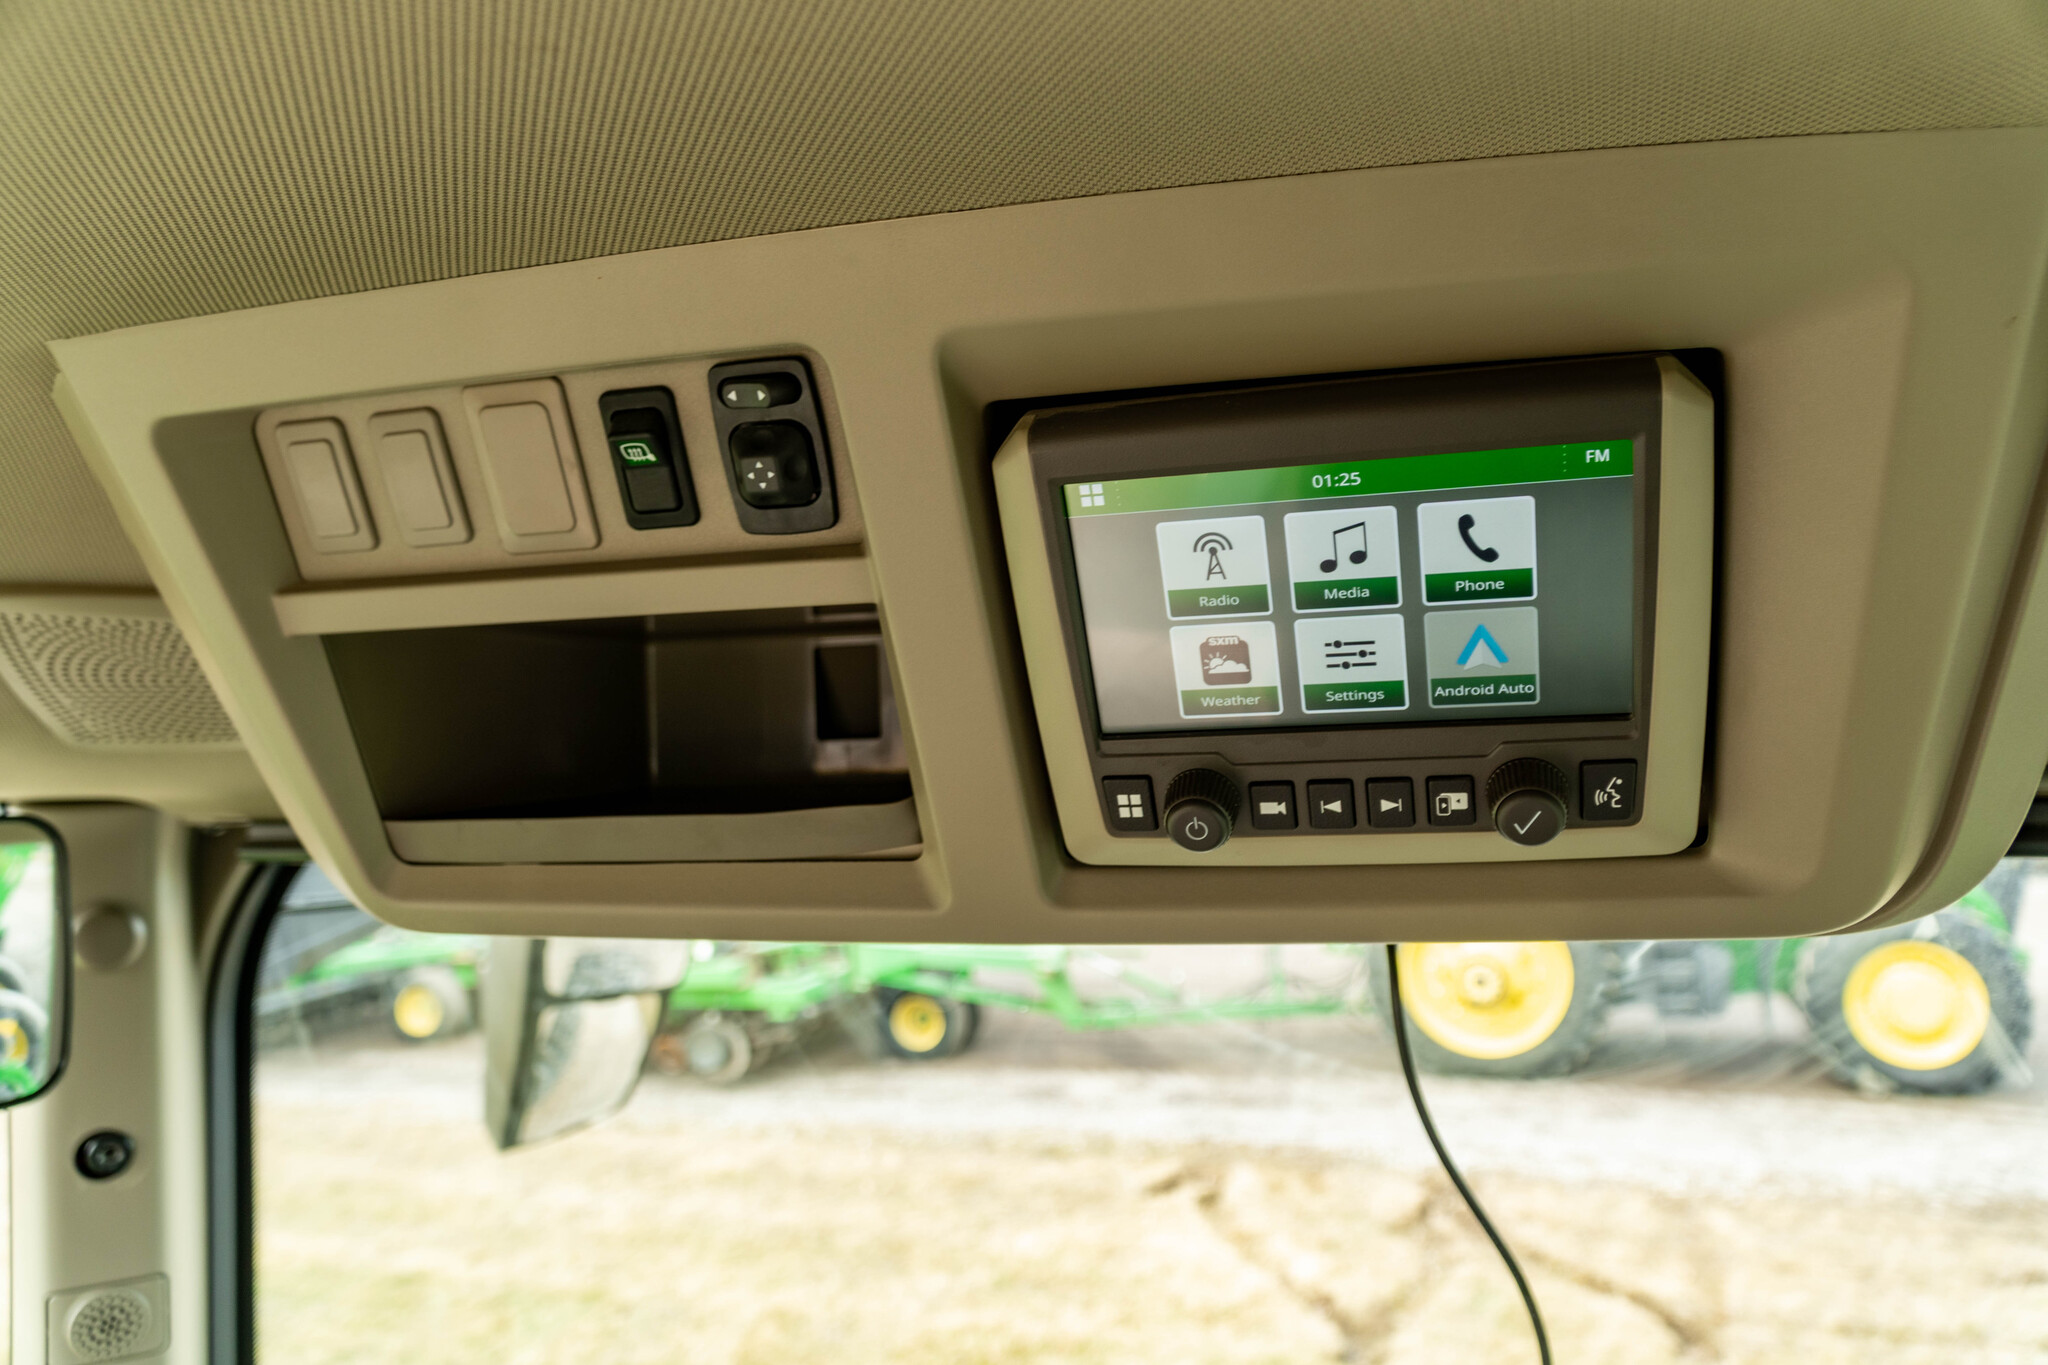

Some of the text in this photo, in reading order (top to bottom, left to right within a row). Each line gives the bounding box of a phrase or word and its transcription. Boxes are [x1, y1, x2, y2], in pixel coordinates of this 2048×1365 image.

[1585, 448, 1610, 464] FM
[1311, 472, 1362, 488] 01:25
[1454, 578, 1505, 592] Phone
[1324, 586, 1370, 600] Media
[1199, 594, 1240, 607] Radio
[1325, 689, 1385, 703] Settings
[1434, 681, 1535, 697] Android Auto
[1200, 694, 1261, 708] Weather
